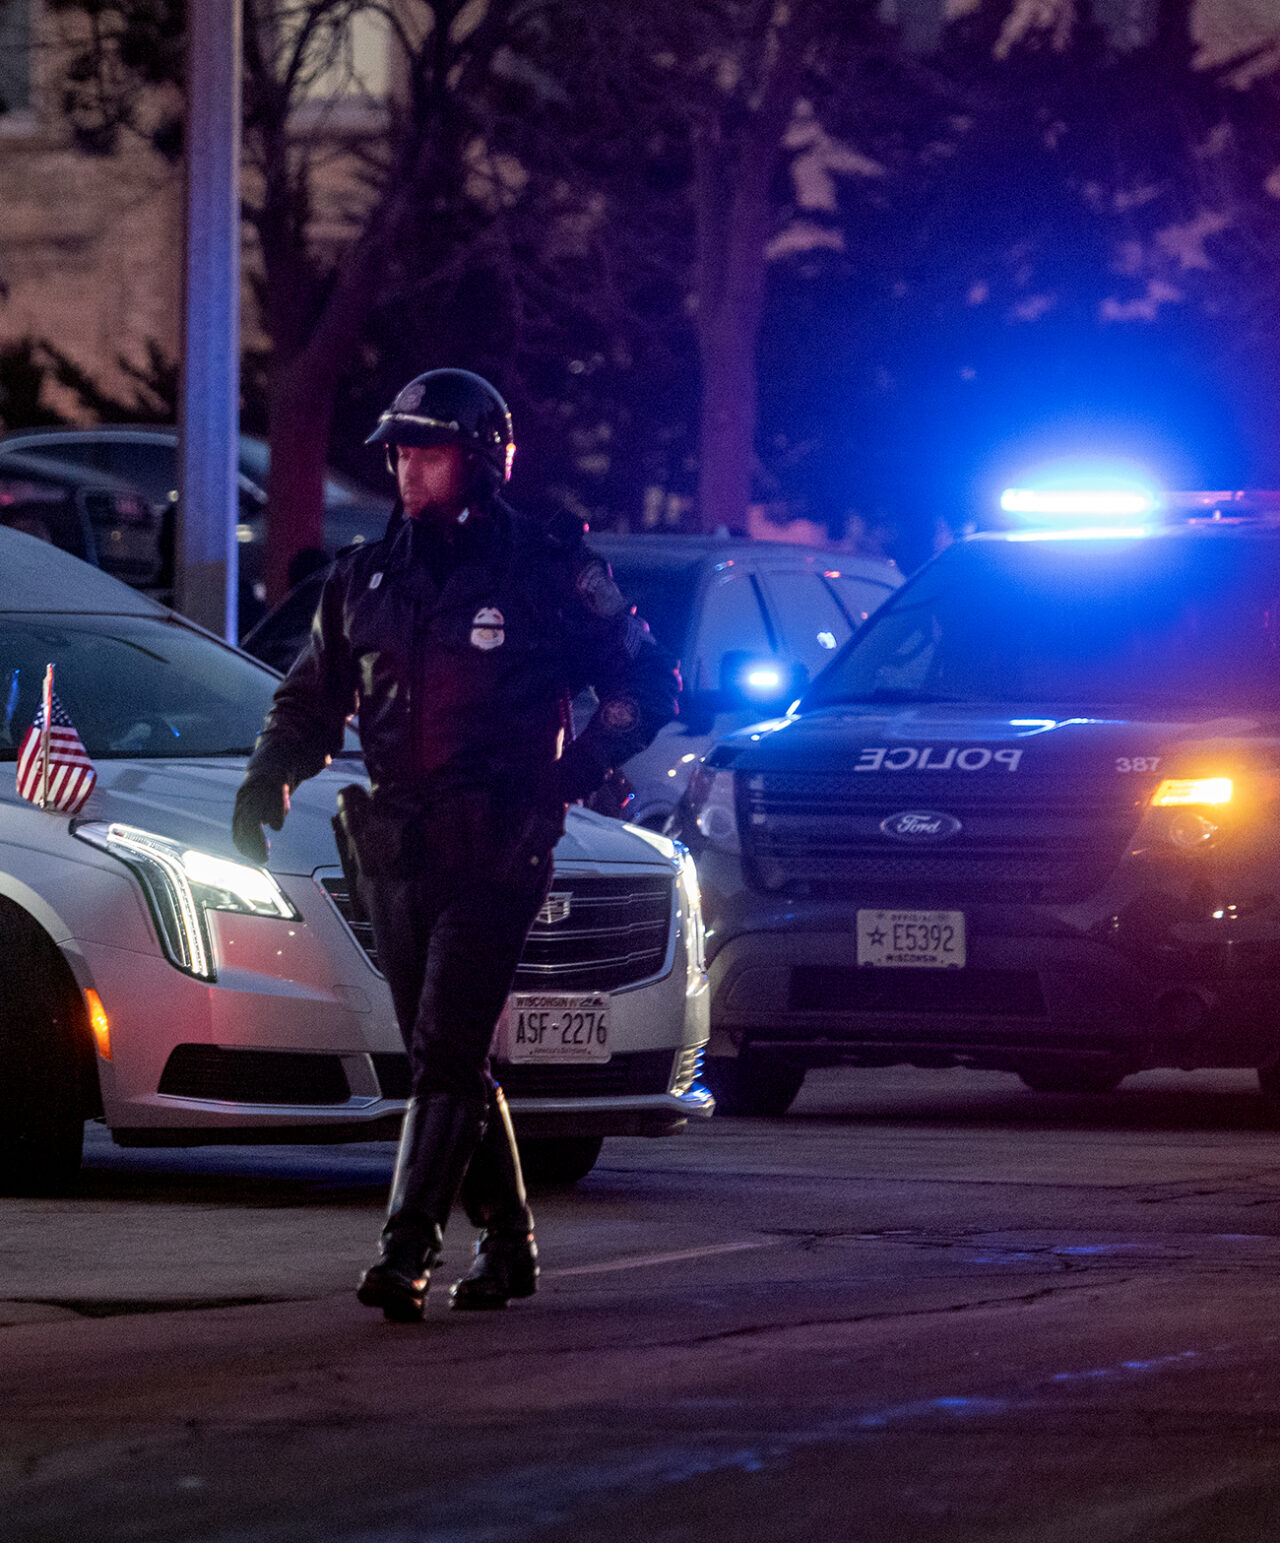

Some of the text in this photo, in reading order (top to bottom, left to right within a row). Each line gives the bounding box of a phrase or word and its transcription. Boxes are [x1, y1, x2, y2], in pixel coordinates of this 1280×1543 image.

[1115, 756, 1161, 773] 387
[897, 814, 942, 834] Ford
[893, 924, 955, 952] E5392
[885, 954, 938, 963] WISCONSIN
[516, 997, 569, 1008] WISCONSIN
[516, 1012, 608, 1045] ASF-2276
